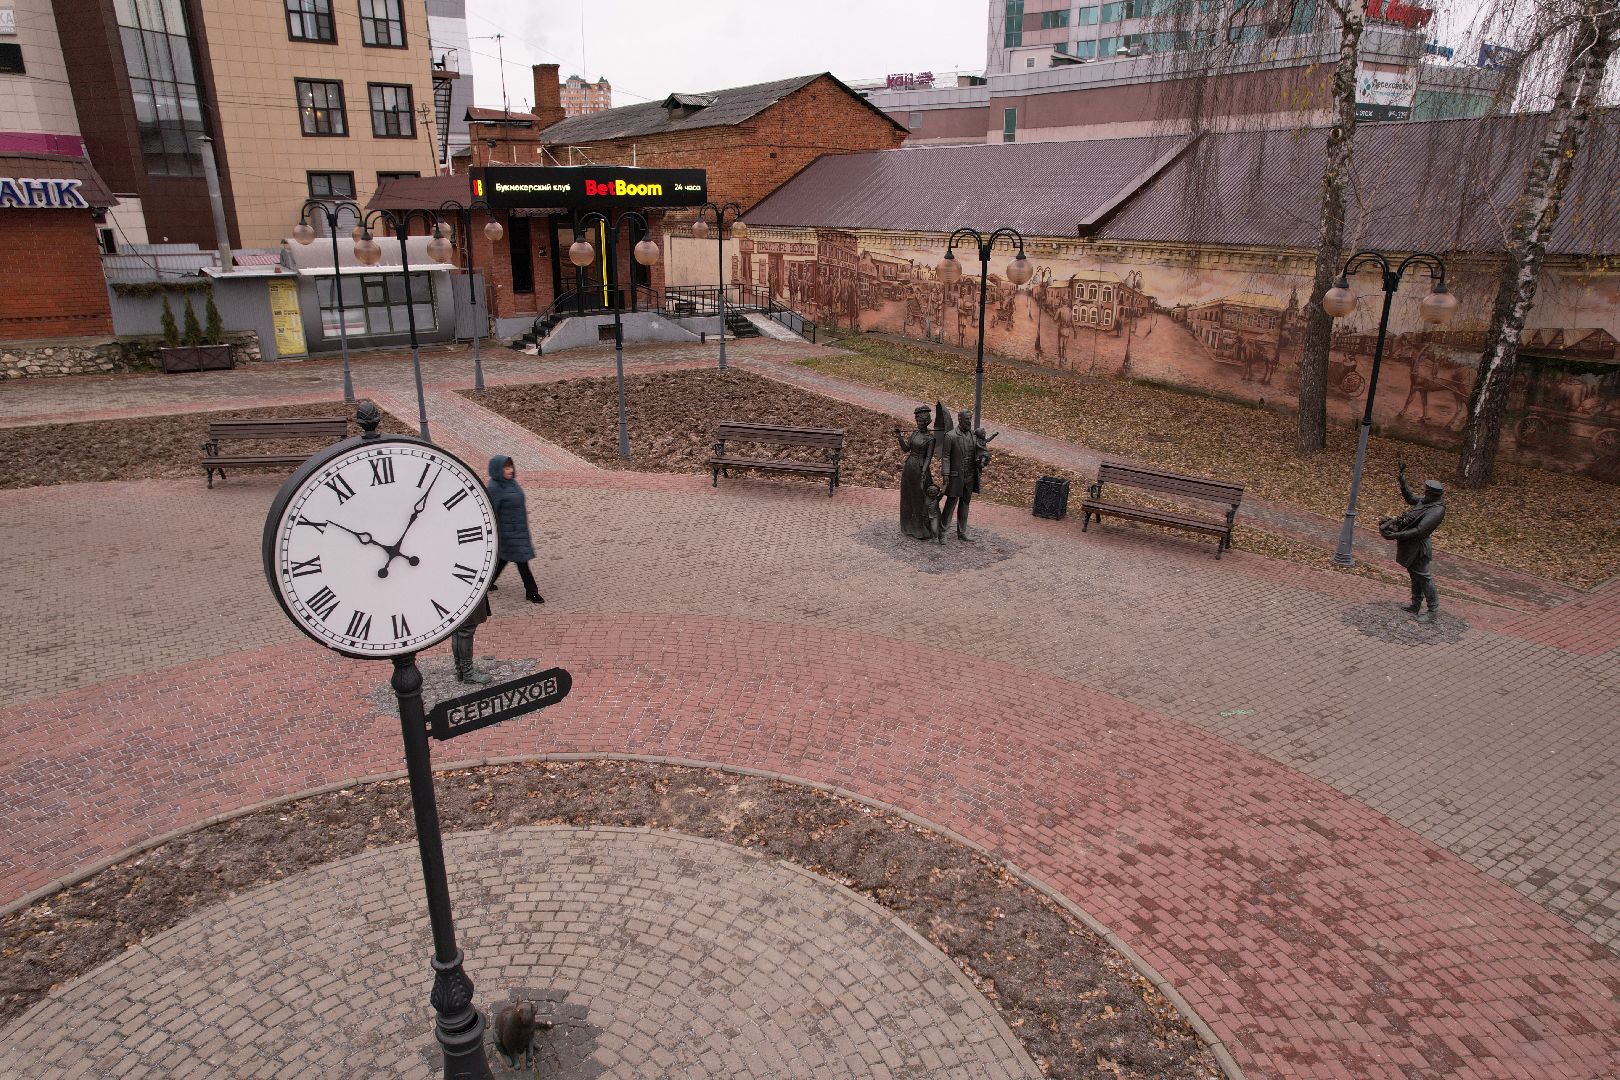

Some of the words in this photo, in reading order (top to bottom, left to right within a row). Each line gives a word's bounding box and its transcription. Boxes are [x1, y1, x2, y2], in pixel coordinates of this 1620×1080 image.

[0, 178, 88, 208] АНК
[495, 183, 552, 193] Букмекерский
[553, 183, 571, 193] клуб
[585, 179, 663, 196] BetBoom
[674, 183, 683, 191] 24
[368, 457, 396, 486] XII
[324, 473, 356, 506] XI
[443, 487, 469, 512] II
[296, 514, 328, 535] X
[456, 525, 483, 545] III
[452, 563, 478, 586] IV
[305, 585, 341, 622] VIII
[344, 610, 372, 640] VII
[448, 679, 556, 726] СЕРПУХОВ
